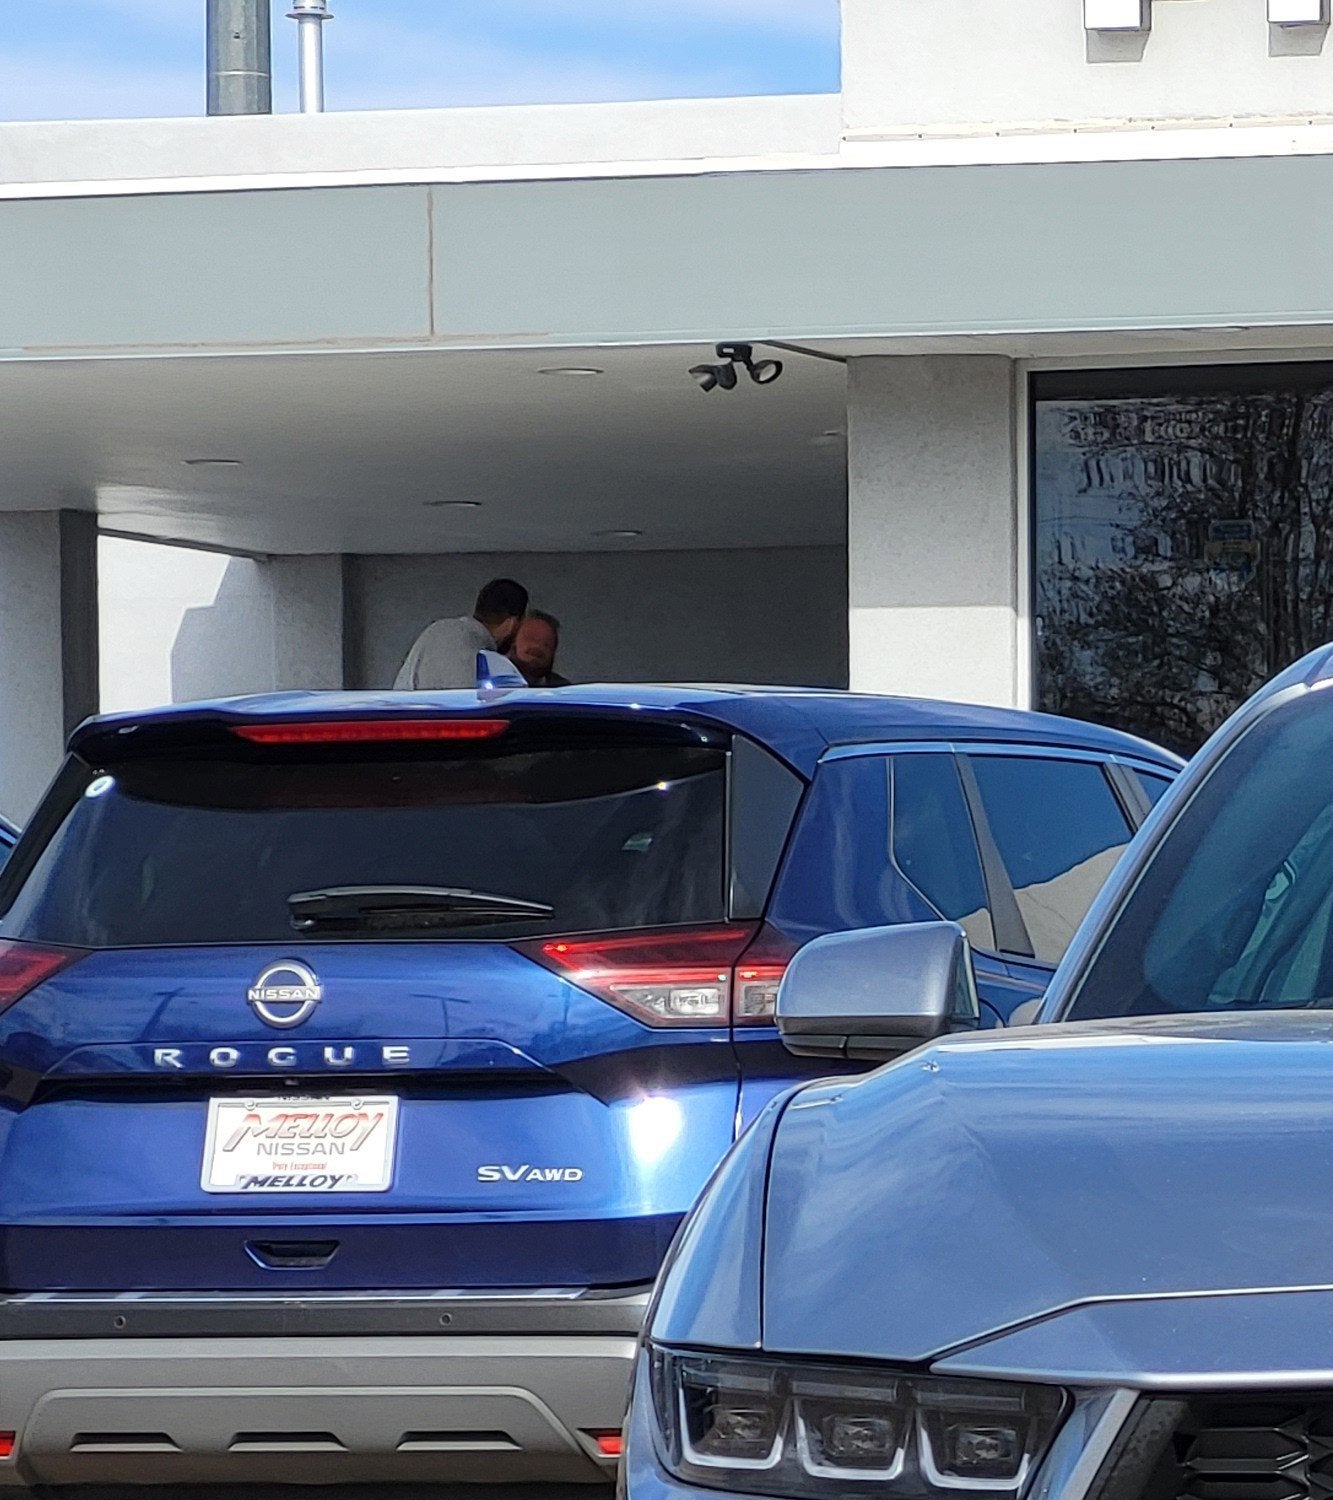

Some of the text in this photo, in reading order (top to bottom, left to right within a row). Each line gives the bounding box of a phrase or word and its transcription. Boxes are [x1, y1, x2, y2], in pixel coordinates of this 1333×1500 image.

[248, 987, 320, 1000] NISSAN
[154, 1046, 411, 1068] ROGUE
[223, 1112, 384, 1152] MELLOY
[257, 1142, 345, 1156] NISSAN
[240, 1174, 345, 1189] MELLOY
